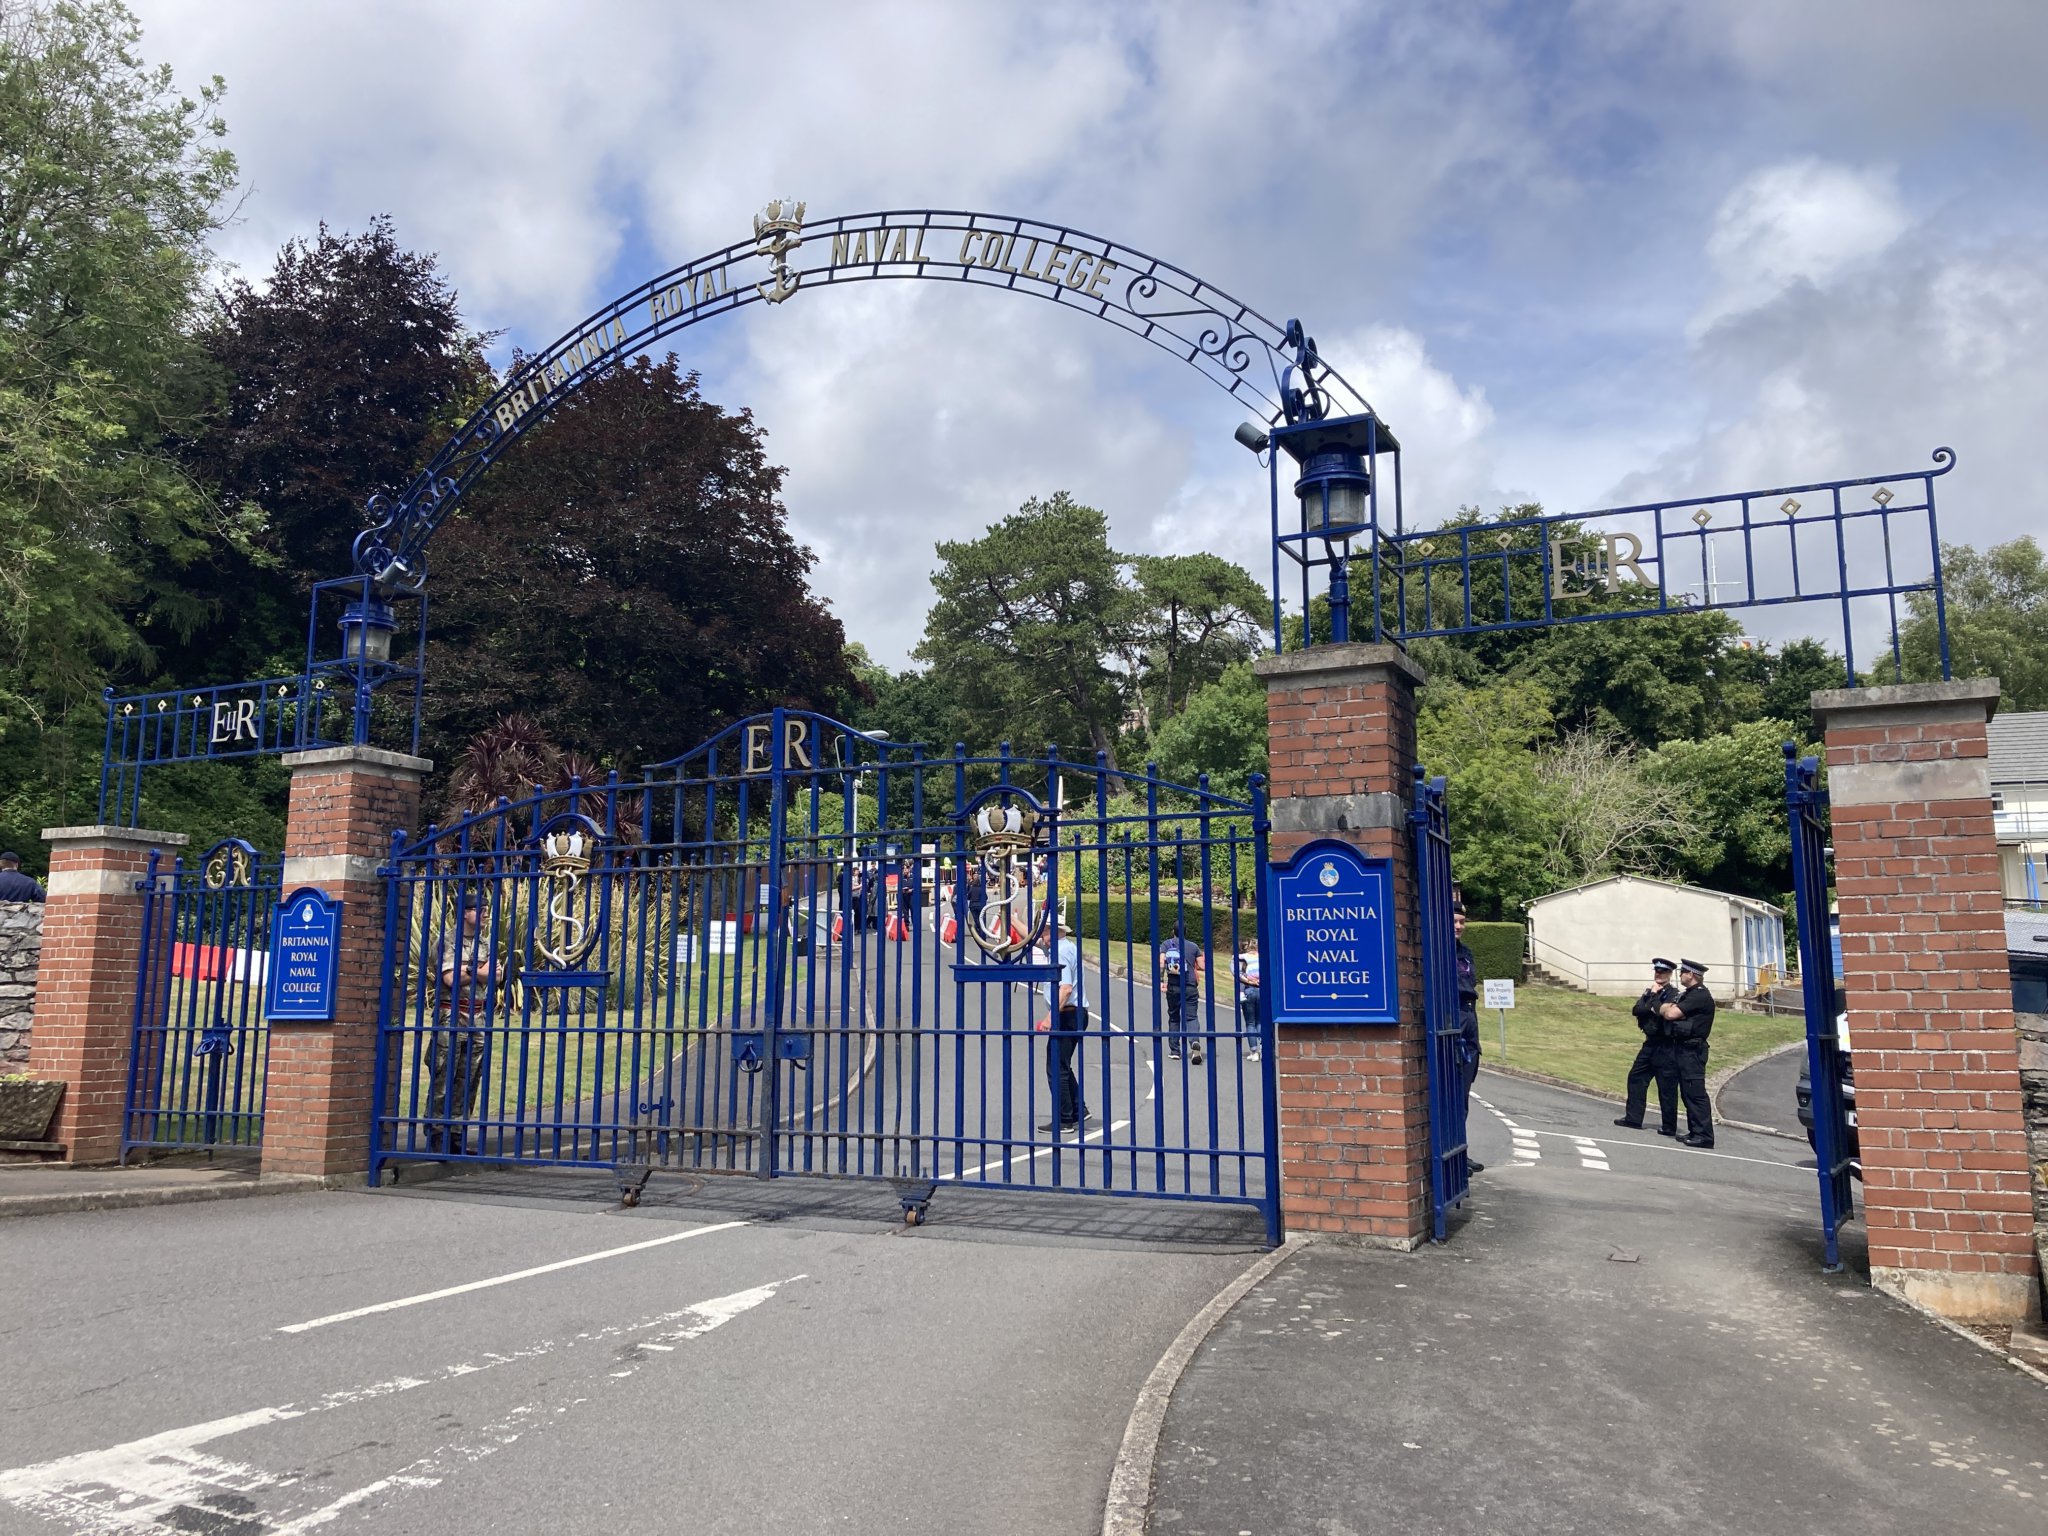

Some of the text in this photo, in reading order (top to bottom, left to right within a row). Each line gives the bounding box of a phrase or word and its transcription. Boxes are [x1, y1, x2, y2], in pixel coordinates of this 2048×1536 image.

[495, 227, 1118, 432] BRITANNIA ROYAL NAVAL COLLEGE
[745, 720, 813, 773] ER
[1286, 906, 1378, 921] BRITANNIA
[282, 936, 330, 947] BRITANNIA
[1306, 928, 1359, 942] ROYAL
[290, 952, 318, 962] ROYAL
[1307, 950, 1359, 963] NAVAL
[289, 967, 317, 977] NAVAL
[1296, 971, 1371, 985] COLLEGE
[282, 982, 322, 993] COLLEGE
